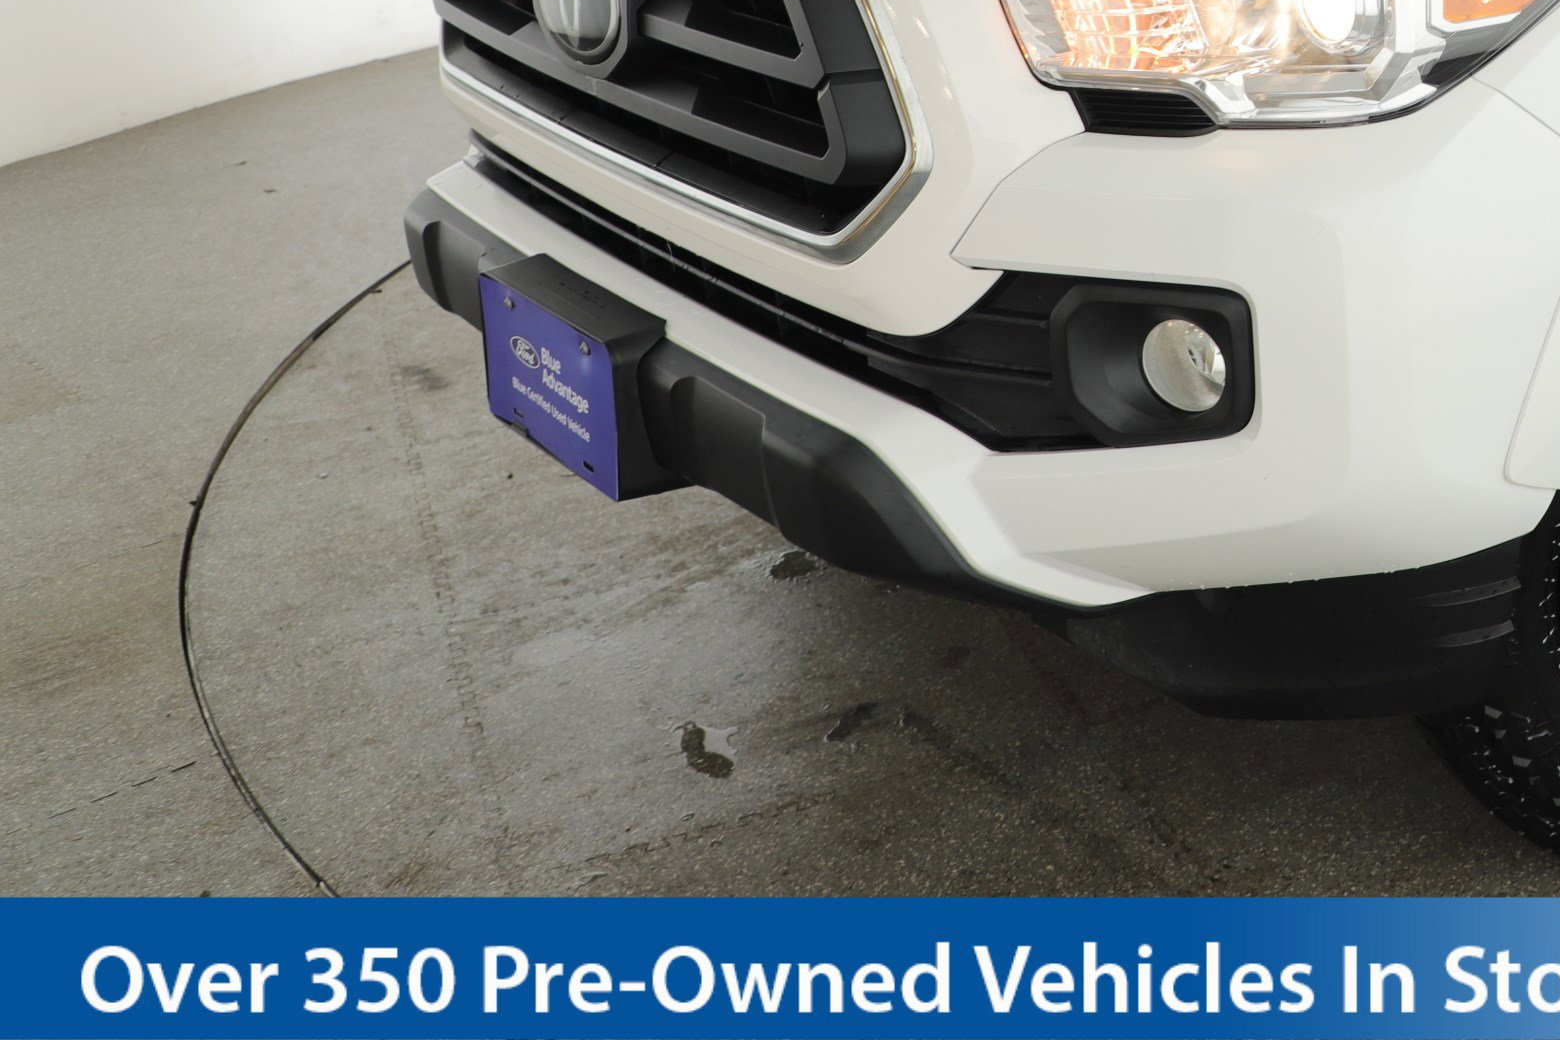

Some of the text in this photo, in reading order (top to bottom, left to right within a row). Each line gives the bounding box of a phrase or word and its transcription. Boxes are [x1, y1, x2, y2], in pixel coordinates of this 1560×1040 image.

[541, 347, 561, 375] Blue
[512, 376, 590, 442] Blue Certified Used Vehicle
[542, 368, 589, 414] Advantage
